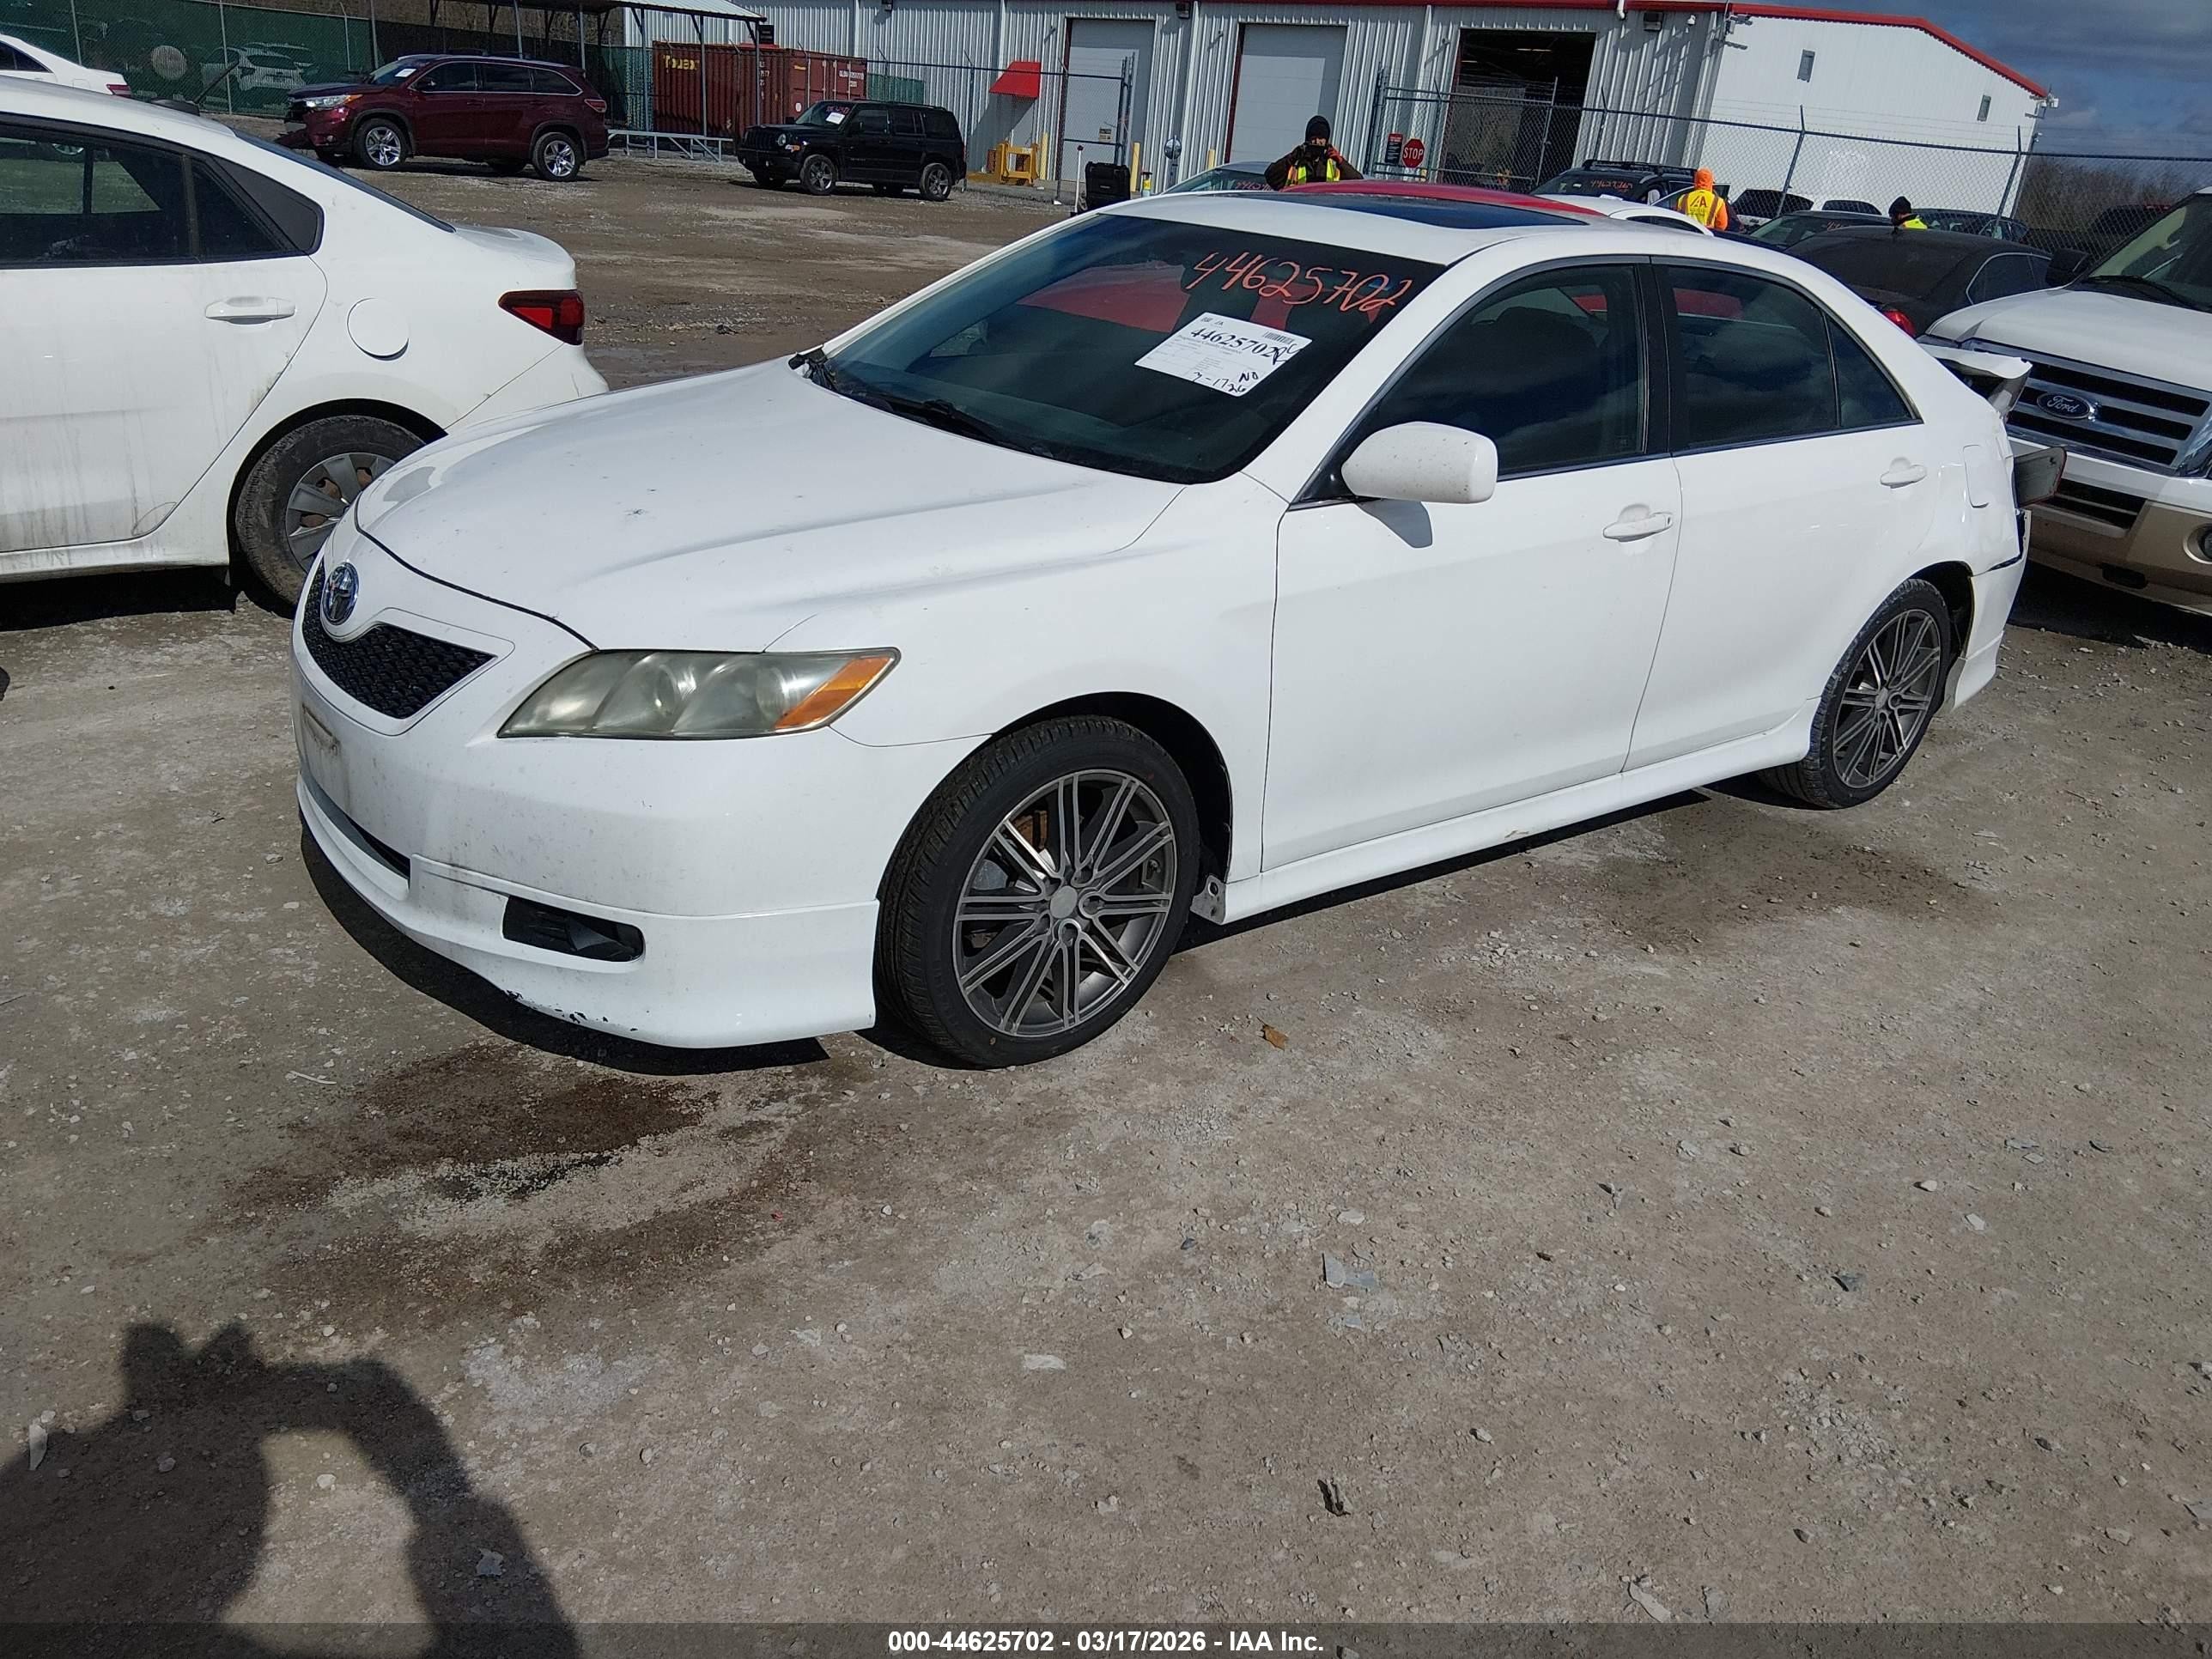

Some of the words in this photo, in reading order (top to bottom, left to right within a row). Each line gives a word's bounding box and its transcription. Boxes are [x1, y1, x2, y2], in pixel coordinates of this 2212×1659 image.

[1403, 147, 1424, 160] STOP
[1185, 252, 1413, 313] 44625702
[1191, 327, 1278, 358] 44625702
[2047, 395, 2080, 412] Ford
